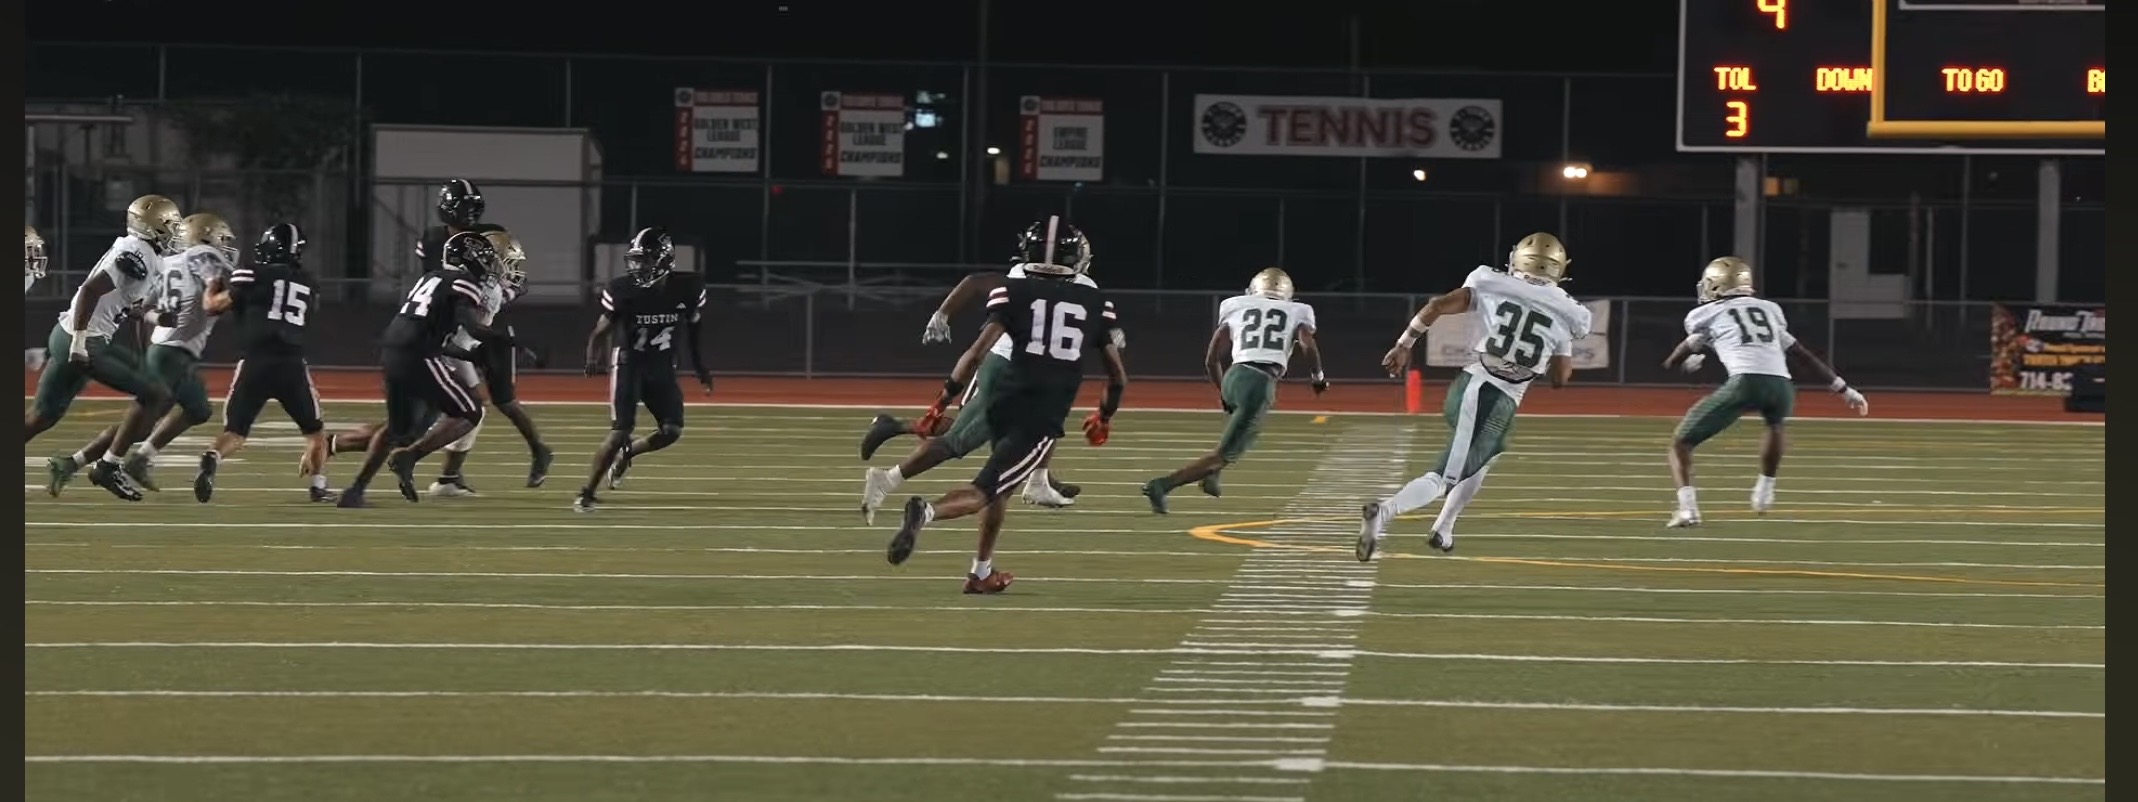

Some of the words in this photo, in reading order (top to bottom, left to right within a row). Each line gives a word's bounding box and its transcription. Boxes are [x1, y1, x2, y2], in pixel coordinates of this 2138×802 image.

[1714, 67, 1757, 90] TOL
[1816, 68, 1873, 91] DOWN
[1942, 68, 1972, 92] TO
[1257, 104, 1438, 149] TENNIS
[1726, 101, 1747, 137] 3
[268, 279, 311, 326] 15
[636, 313, 679, 324] TUSTIN
[634, 326, 677, 352] 14
[1025, 298, 1088, 362] 16
[1240, 308, 1288, 350] 22
[1486, 300, 1553, 368] 35
[1728, 307, 1774, 344] 19
